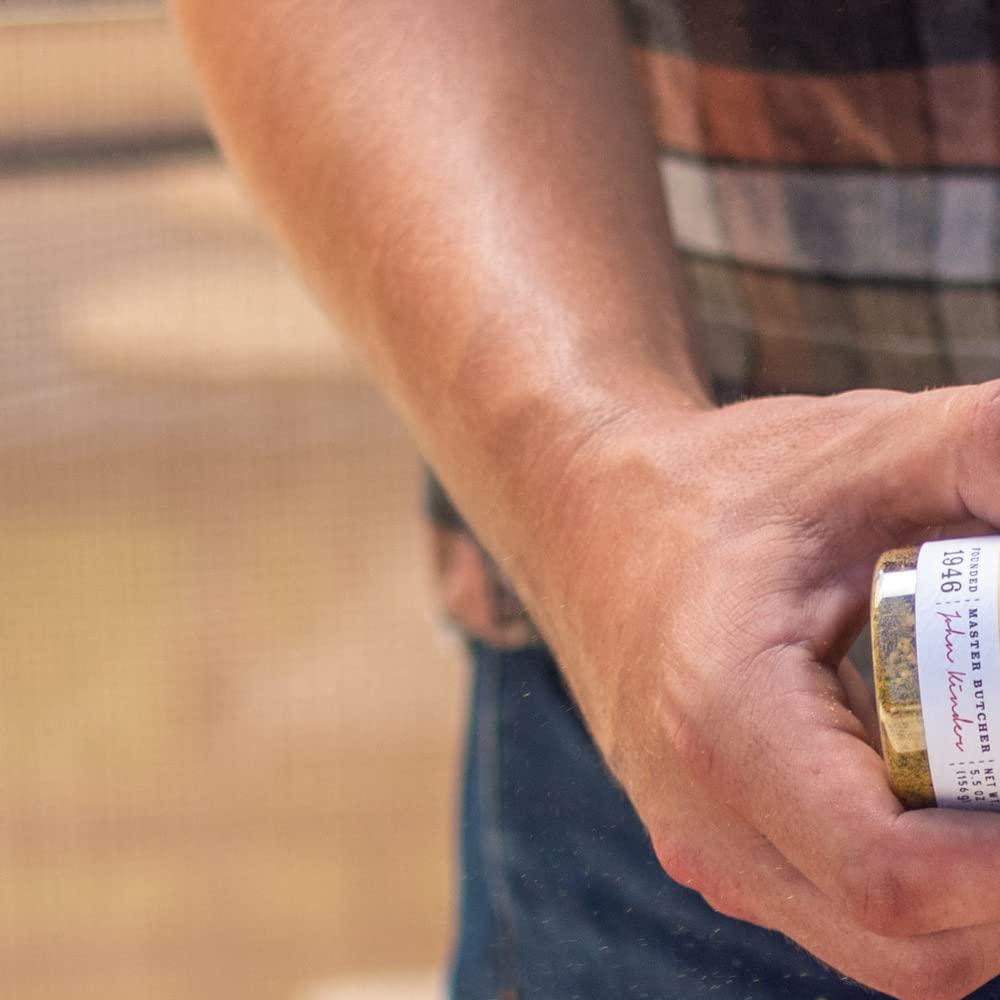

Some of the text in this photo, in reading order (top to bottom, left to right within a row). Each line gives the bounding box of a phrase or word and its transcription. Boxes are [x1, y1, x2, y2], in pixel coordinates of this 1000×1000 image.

[940, 550, 965, 593] 1946
[968, 608, 991, 753] MASTER BUTCHER
[969, 769, 985, 801] 5.5 OZ
[984, 768, 997, 787] NET
